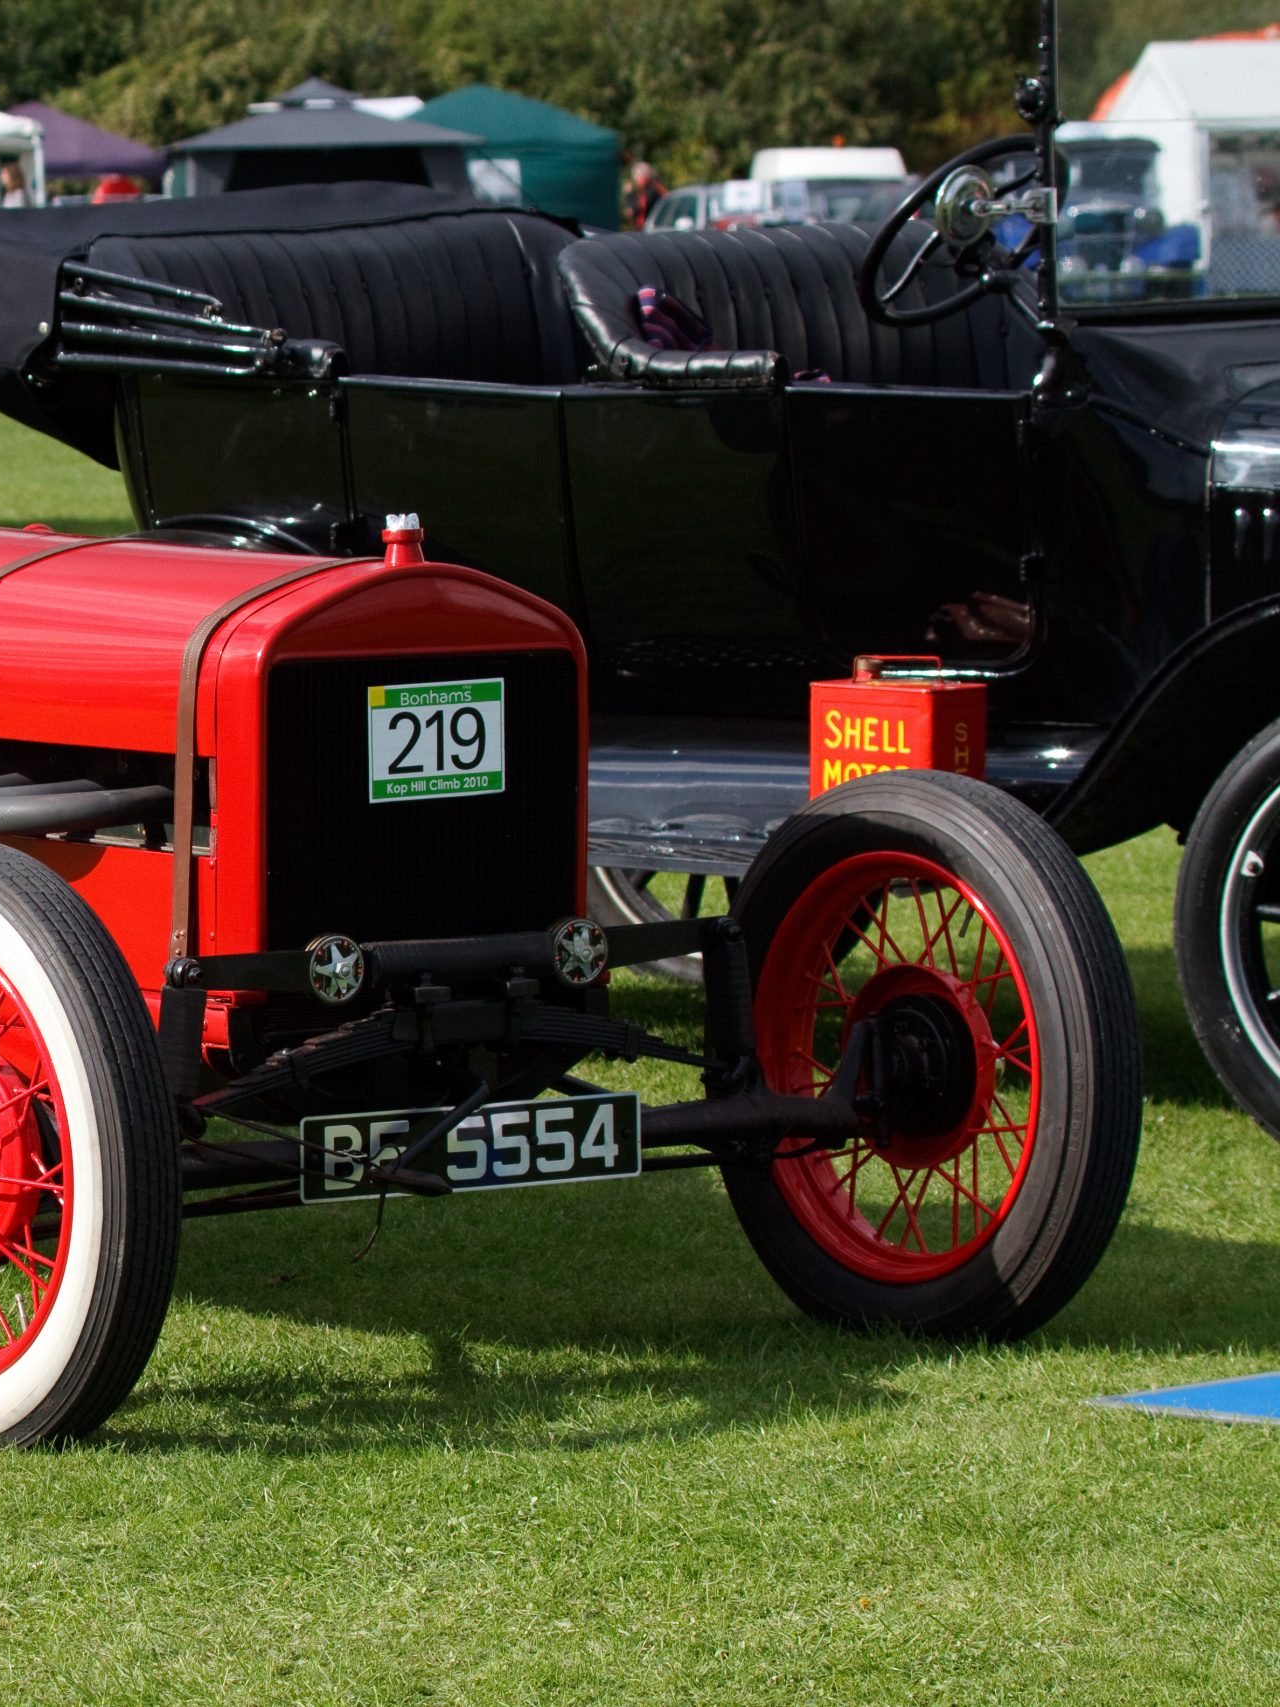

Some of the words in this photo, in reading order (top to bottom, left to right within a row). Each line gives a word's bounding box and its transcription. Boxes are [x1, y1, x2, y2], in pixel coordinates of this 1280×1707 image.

[400, 690, 472, 706] Bonhams
[388, 706, 486, 775] 219
[824, 709, 911, 754] SHELL
[954, 722, 970, 775] SH
[387, 782, 408, 795] Kop
[411, 780, 426, 793] Hill
[429, 778, 461, 791] Climb
[464, 776, 488, 788] 2010
[446, 1104, 620, 1182] 5554
